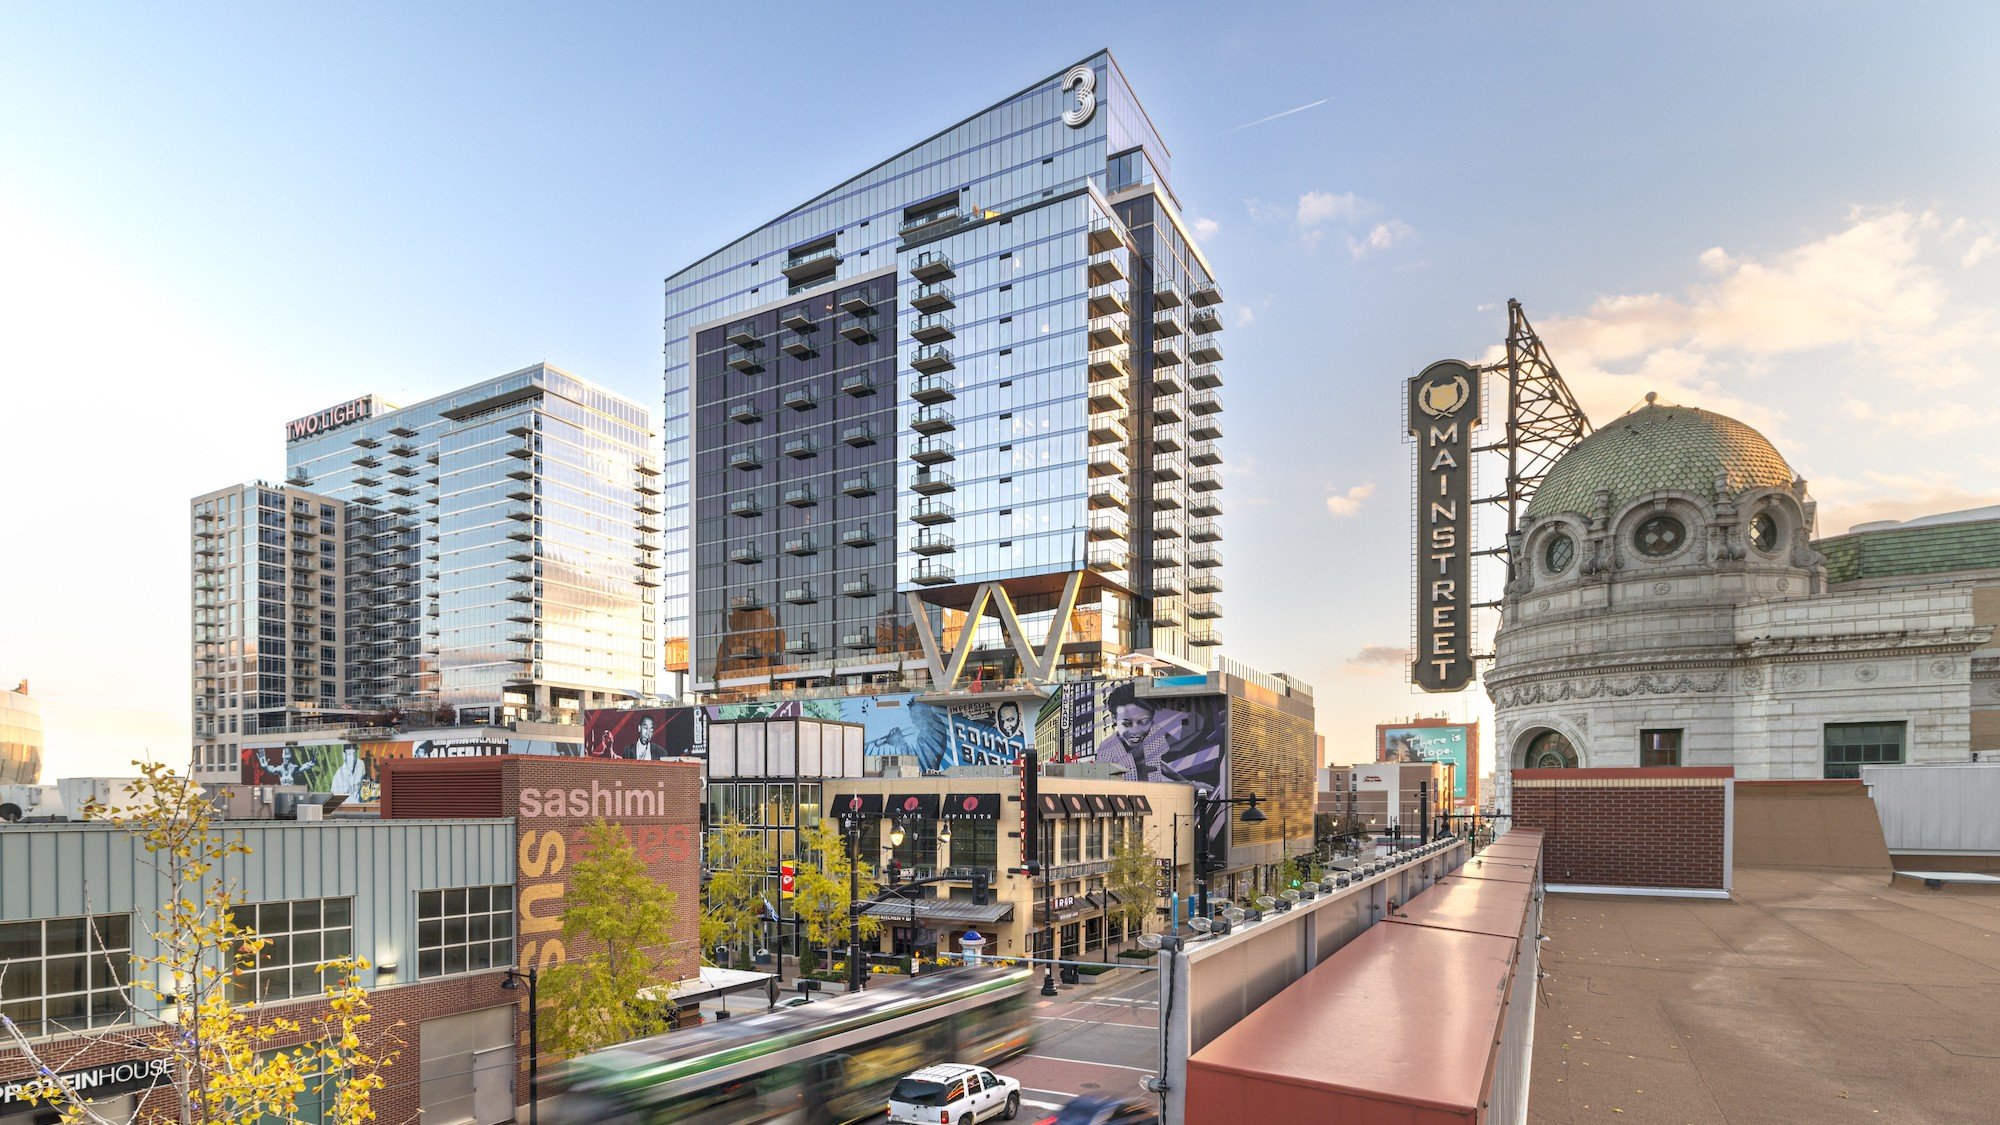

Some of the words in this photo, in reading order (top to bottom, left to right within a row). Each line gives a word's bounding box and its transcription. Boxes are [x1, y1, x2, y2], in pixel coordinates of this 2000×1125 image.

[1061, 64, 1097, 128] 3
[286, 414, 318, 440] TWO
[321, 397, 368, 429] LIGHT
[1406, 734, 1447, 748] There
[1451, 733, 1462, 742] is
[1416, 747, 1453, 761] Hope.
[519, 779, 665, 818] sashimi
